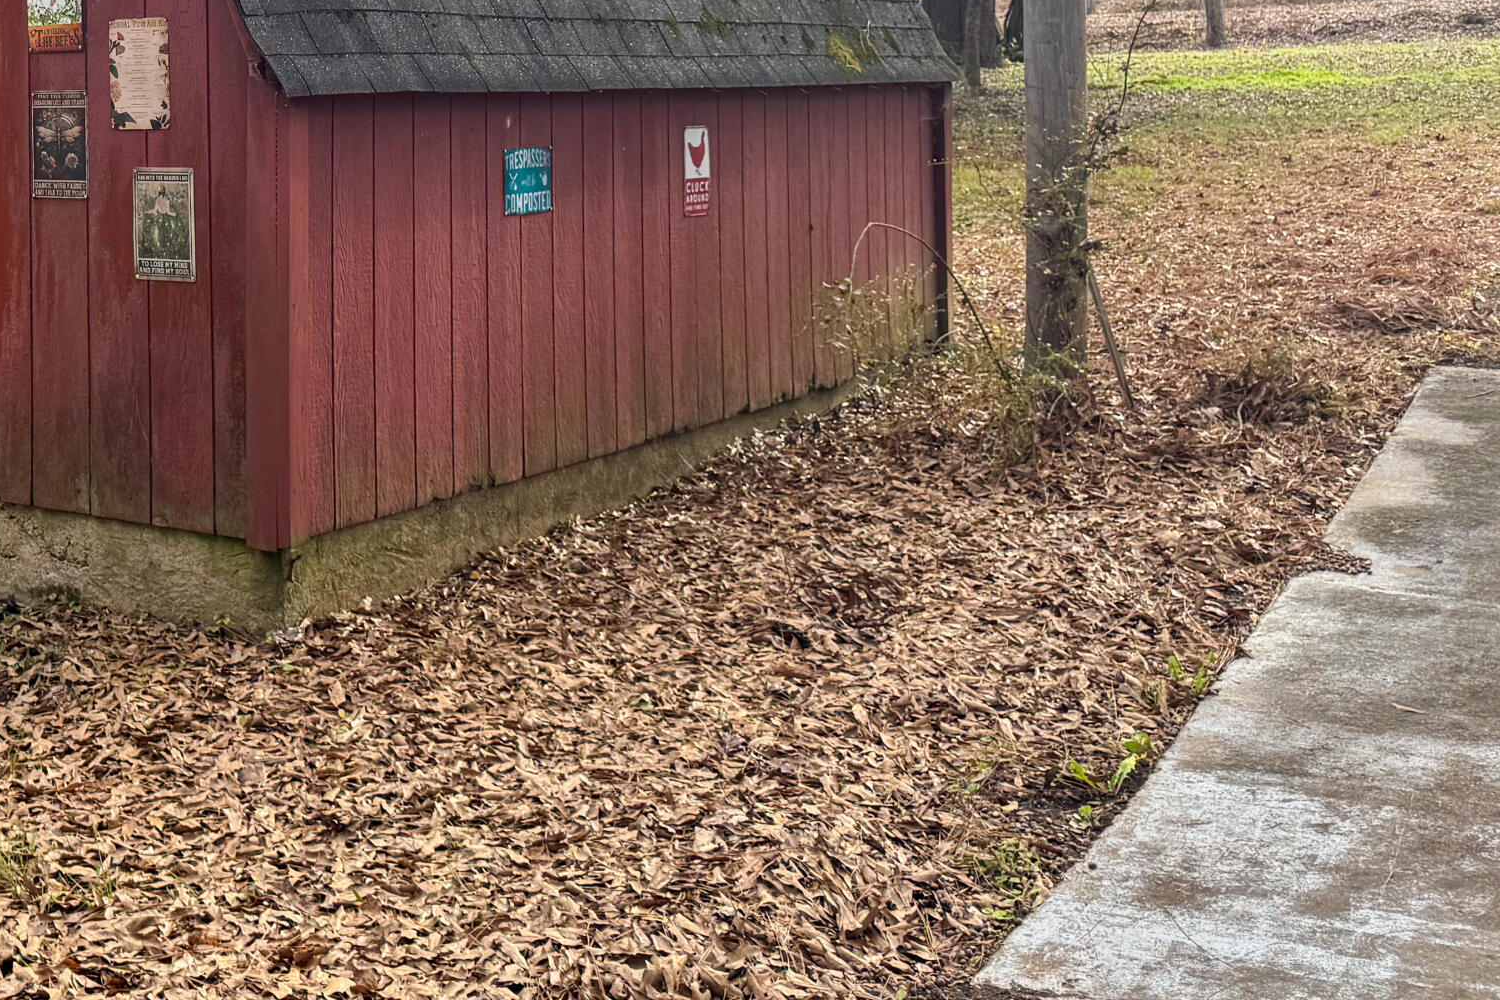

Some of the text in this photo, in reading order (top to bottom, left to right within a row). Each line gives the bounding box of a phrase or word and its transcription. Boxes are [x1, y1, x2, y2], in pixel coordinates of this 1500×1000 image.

[31, 27, 80, 48] THE BEES
[505, 148, 551, 170] TRESPASSERS
[686, 181, 709, 193] CLUCK
[505, 190, 552, 214] COMPOSTED
[686, 193, 709, 203] AROUND
